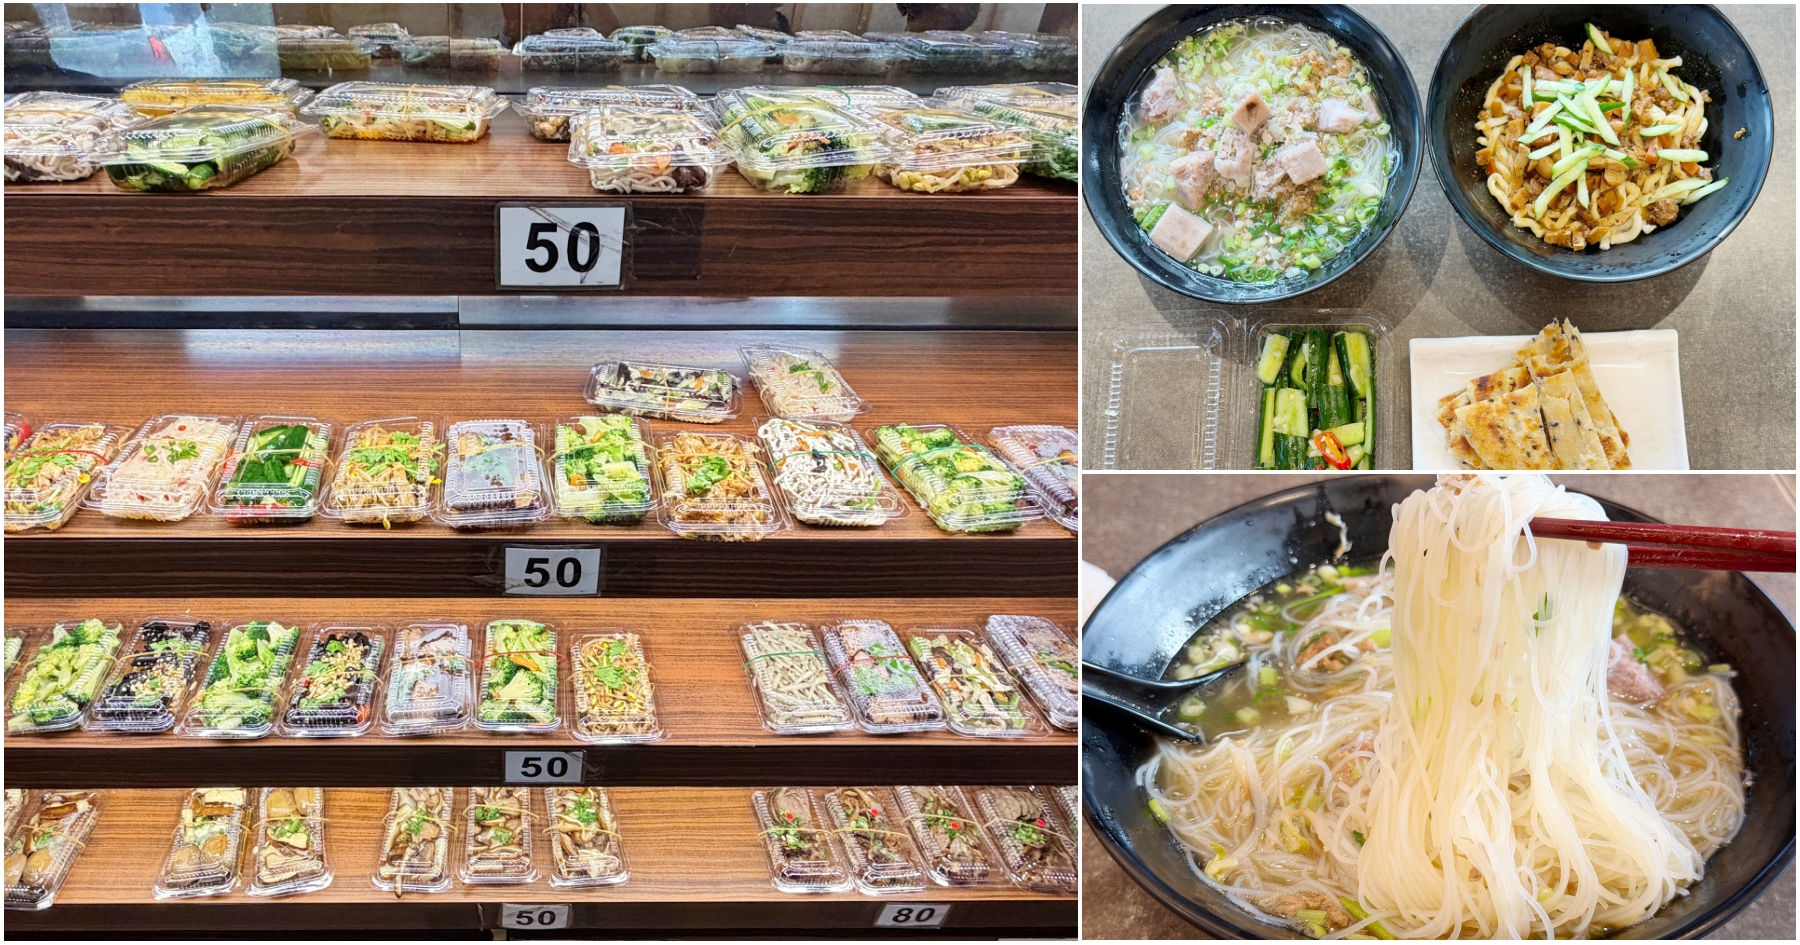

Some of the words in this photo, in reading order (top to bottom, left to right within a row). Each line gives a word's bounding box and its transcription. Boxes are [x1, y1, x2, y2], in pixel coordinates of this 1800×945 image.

[523, 221, 601, 274] 50
[523, 556, 582, 588] 50
[520, 756, 569, 778] 50
[515, 909, 557, 926] 50
[891, 907, 936, 923] 80
